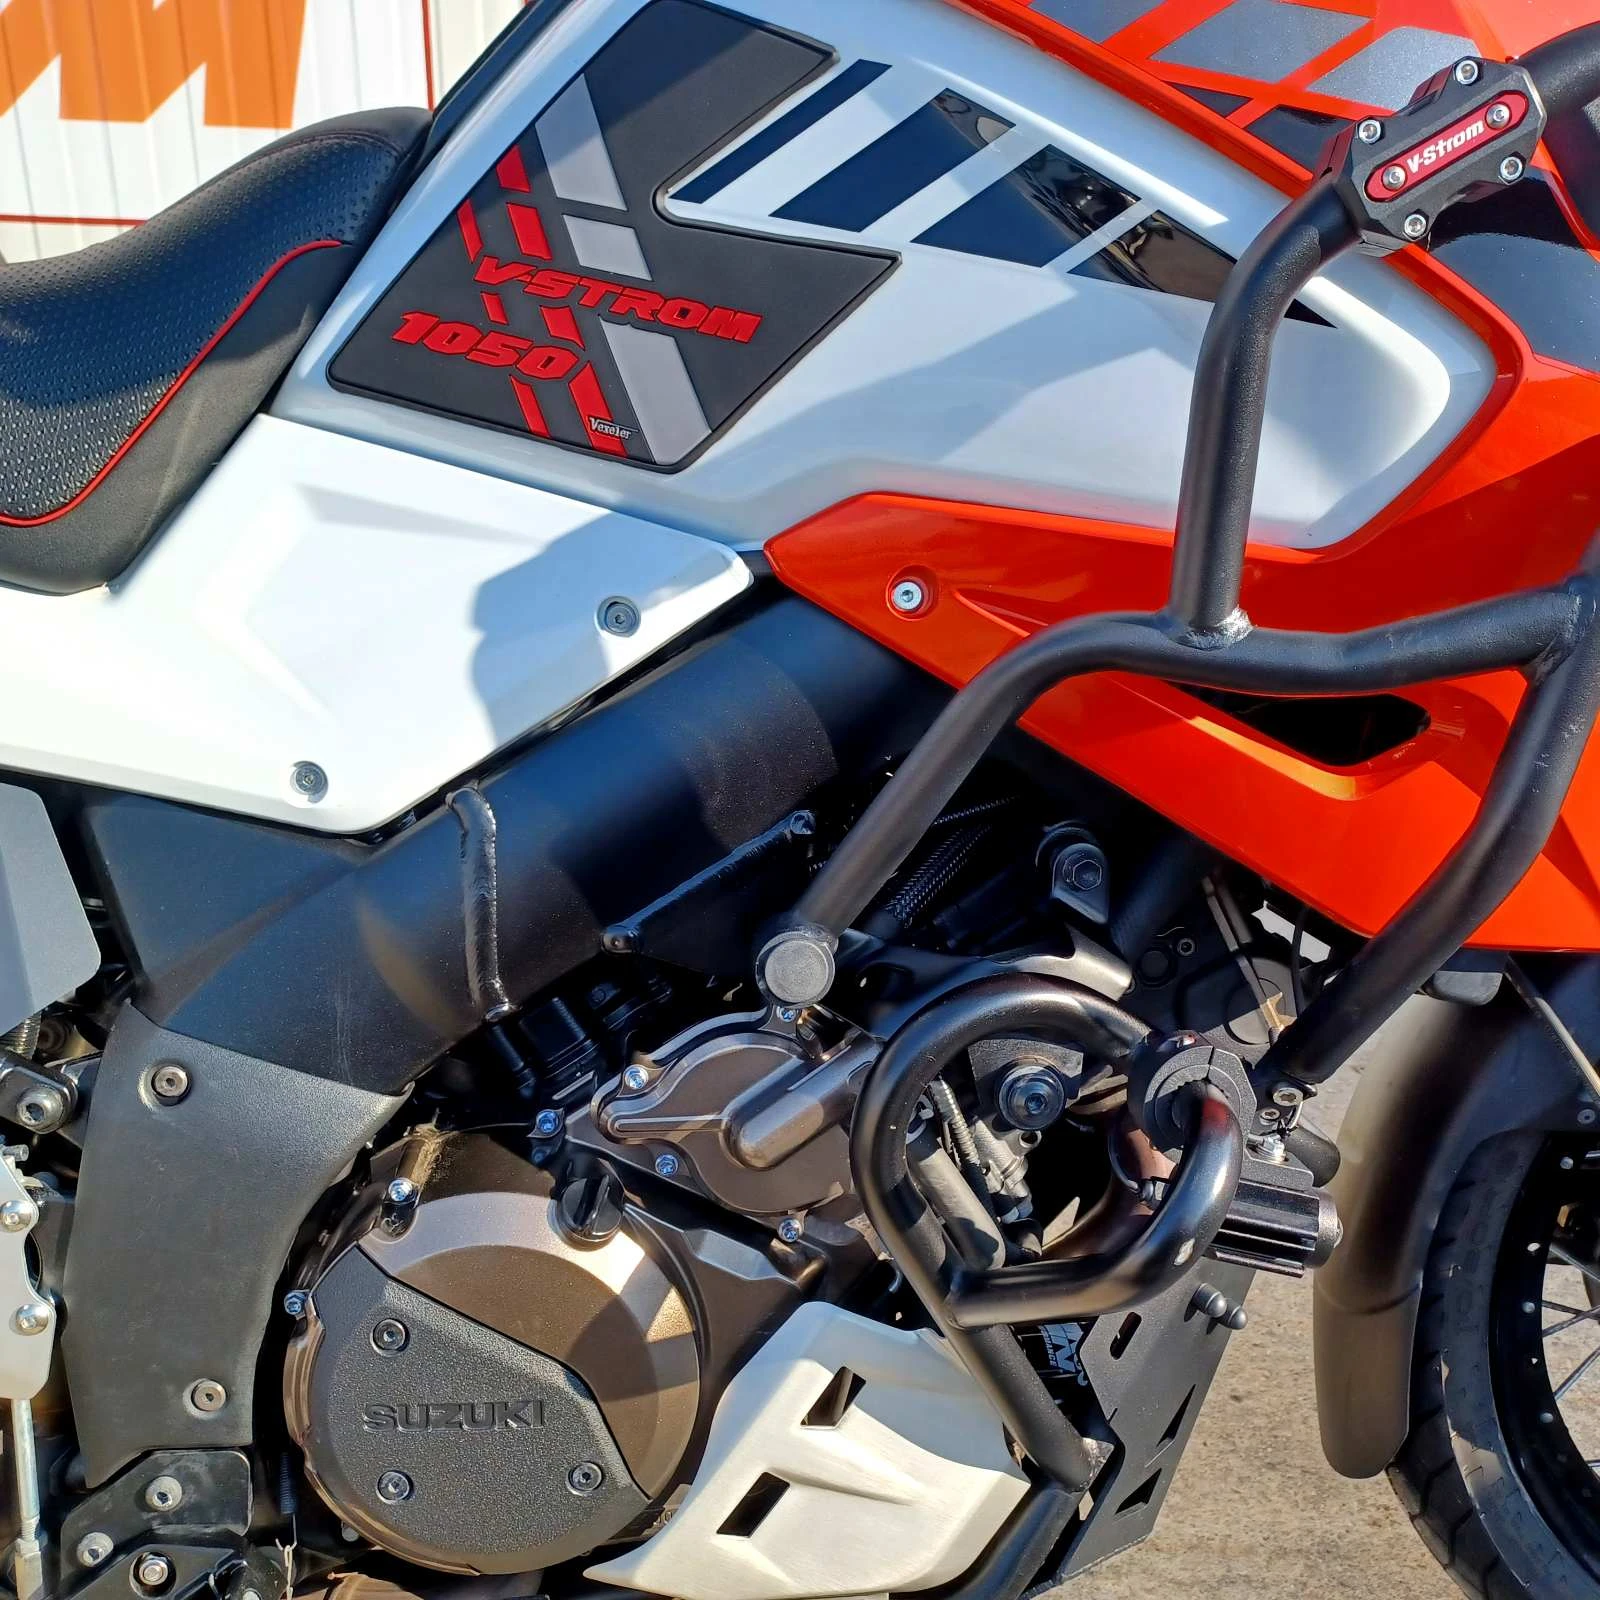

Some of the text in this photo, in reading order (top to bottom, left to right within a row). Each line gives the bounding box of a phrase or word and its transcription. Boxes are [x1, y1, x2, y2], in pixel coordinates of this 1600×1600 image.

[1406, 120, 1485, 174] V-Strom
[473, 255, 763, 344] V-STROM
[391, 311, 580, 380] 1050
[363, 1401, 544, 1431] SUZUKI
